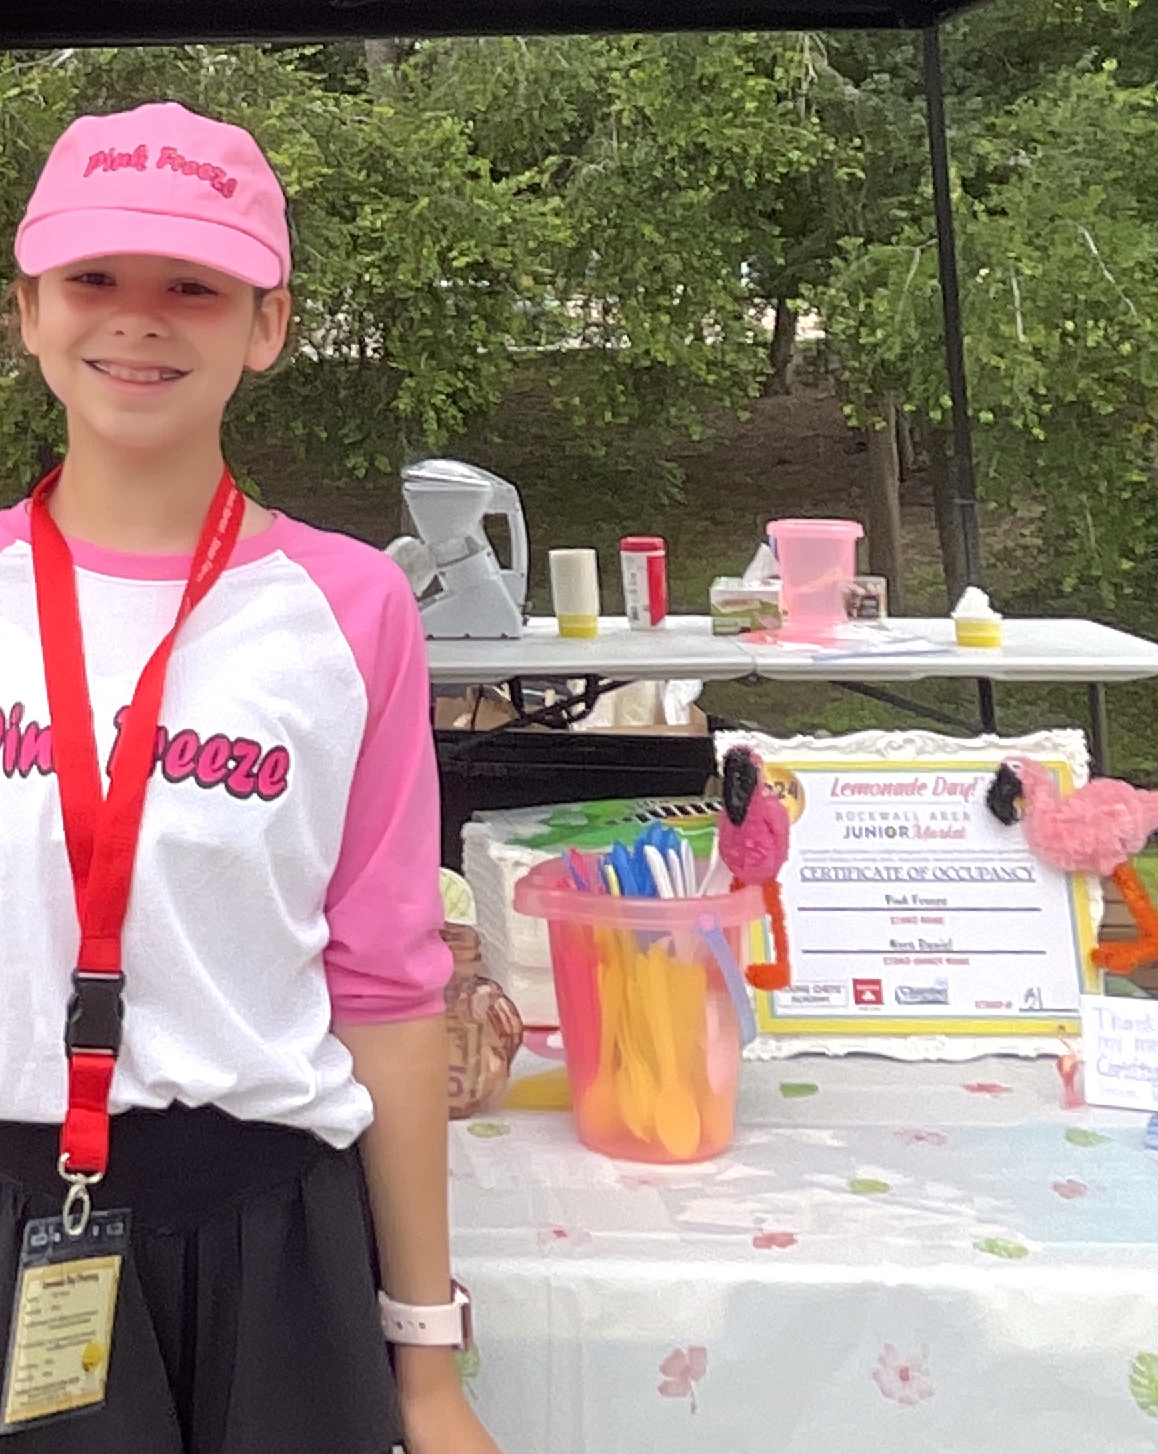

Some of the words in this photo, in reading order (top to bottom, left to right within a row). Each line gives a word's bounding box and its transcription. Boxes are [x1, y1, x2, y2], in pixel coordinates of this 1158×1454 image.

[83, 144, 148, 177] Pink
[156, 146, 237, 199] Freeze
[831, 777, 928, 797] Lemonade
[835, 811, 920, 822] ROCKWALL
[929, 811, 971, 822] AREA
[843, 826, 909, 839] JUNIOR
[800, 866, 904, 881] CERTIFICATE
[906, 866, 929, 881] OF
[932, 865, 1034, 881] OCCUPANCY
